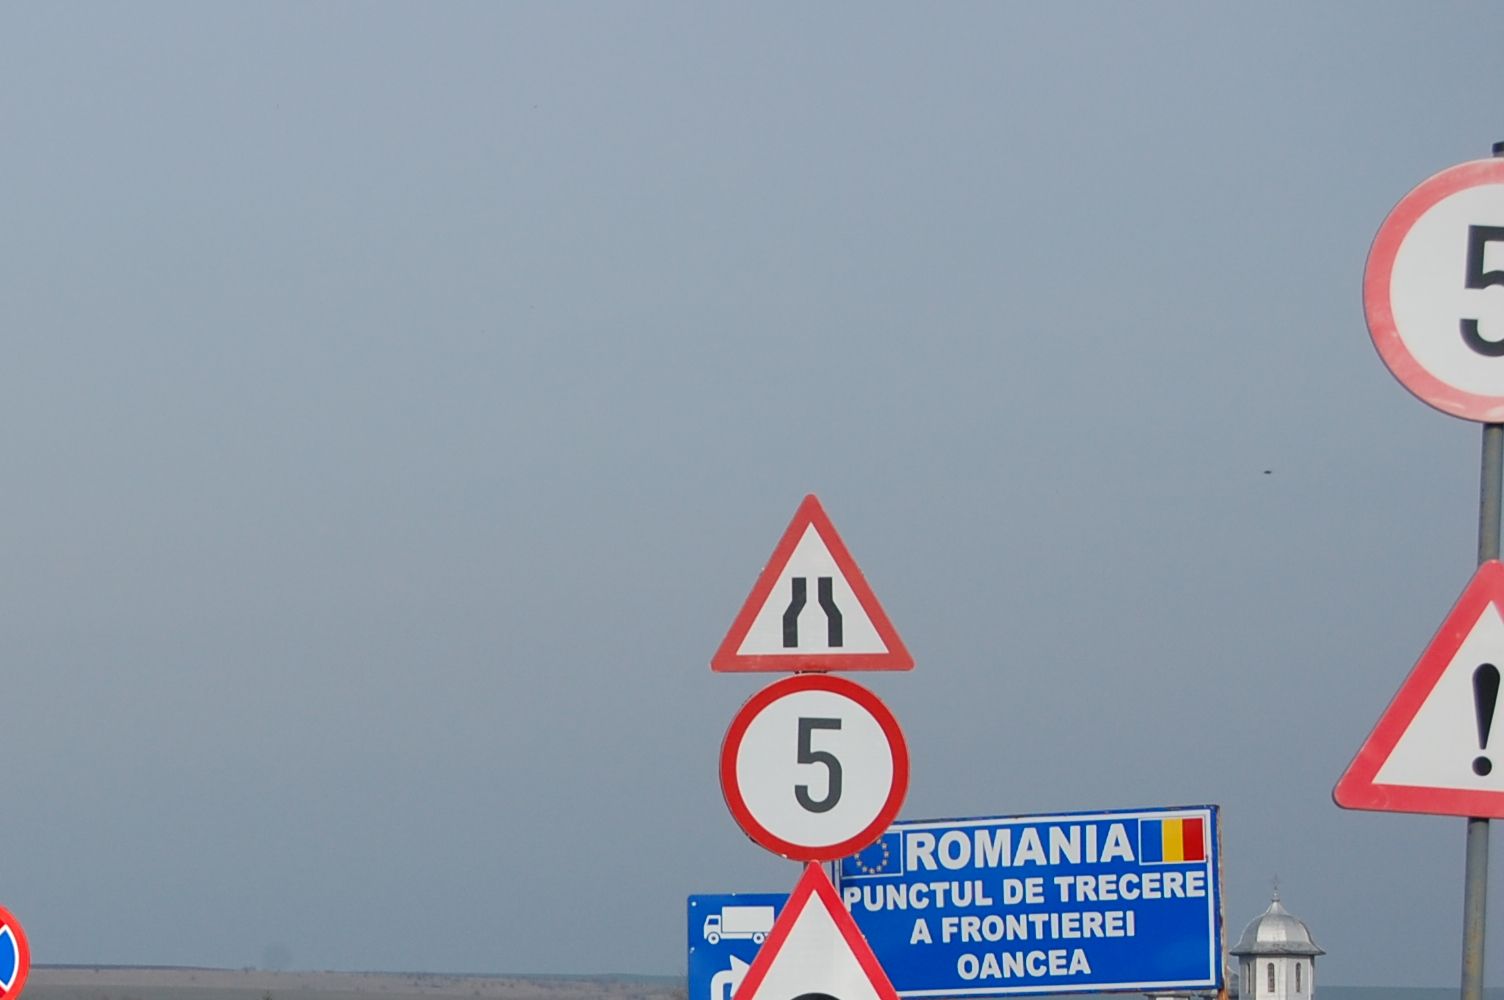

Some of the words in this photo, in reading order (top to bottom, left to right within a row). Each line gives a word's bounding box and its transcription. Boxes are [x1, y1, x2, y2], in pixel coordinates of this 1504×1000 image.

[1459, 224, 1504, 358] 5
[794, 717, 843, 813] 5
[906, 823, 1135, 872] ROMANIA
[844, 880, 993, 912] PUNCTUL
[1003, 878, 1044, 905] DE
[1054, 871, 1206, 902] TRECERE
[910, 918, 932, 945] A
[942, 910, 1135, 943] FRONTIEREI
[957, 949, 1091, 980] OANCEA
